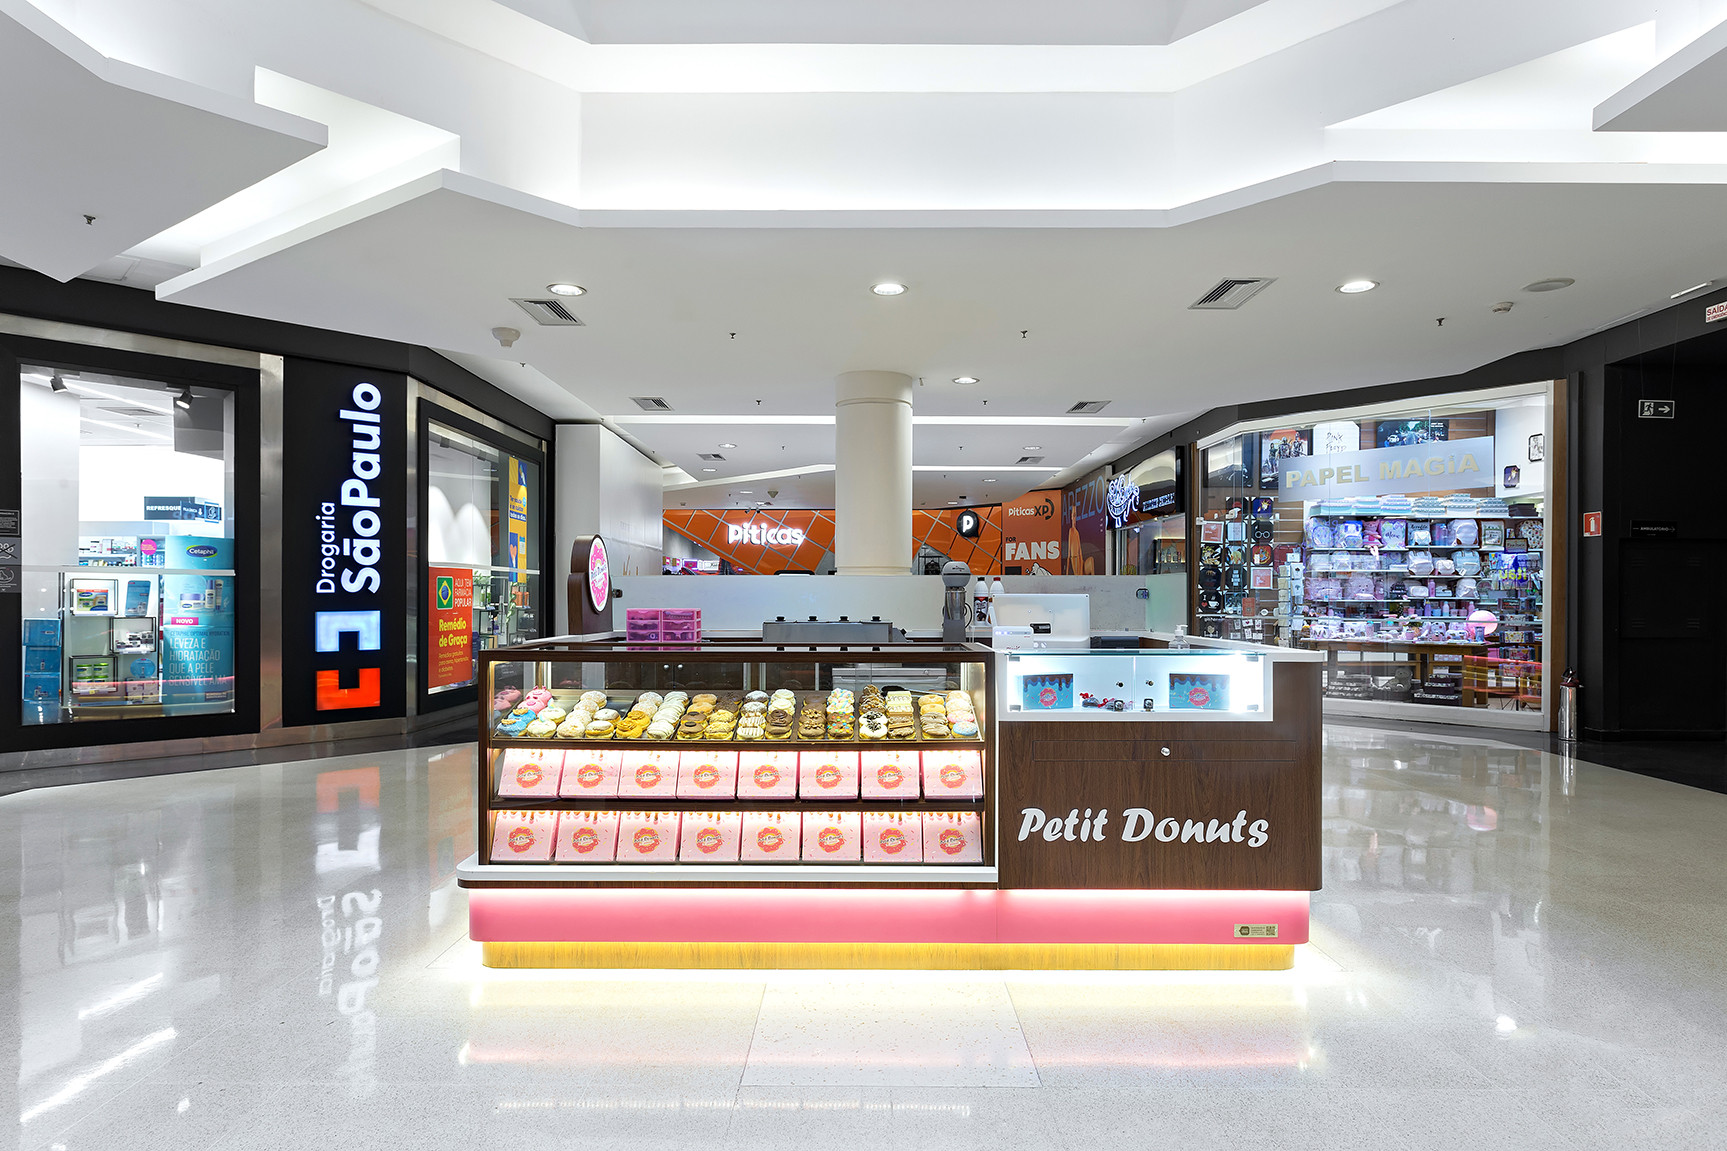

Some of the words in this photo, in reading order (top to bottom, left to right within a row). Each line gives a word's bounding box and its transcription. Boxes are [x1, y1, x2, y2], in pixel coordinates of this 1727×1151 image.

[1286, 464, 1370, 488] PAPEL
[1062, 475, 1106, 526] AREZZO
[316, 502, 340, 594] Drogaria
[1005, 541, 1060, 560] FANS
[455, 598, 472, 607] POPULAR
[439, 617, 467, 632] Remédio
[170, 638, 199, 649] LEVEZA
[201, 638, 206, 648] E
[439, 635, 447, 647] de
[448, 633, 468, 648] Graça
[169, 648, 220, 661] HIDRATAÇÃO
[169, 662, 185, 674] QUE
[187, 662, 194, 673] A
[195, 662, 214, 673] PELE
[1018, 808, 1108, 842] Petit
[1121, 808, 1269, 848] Donuts
